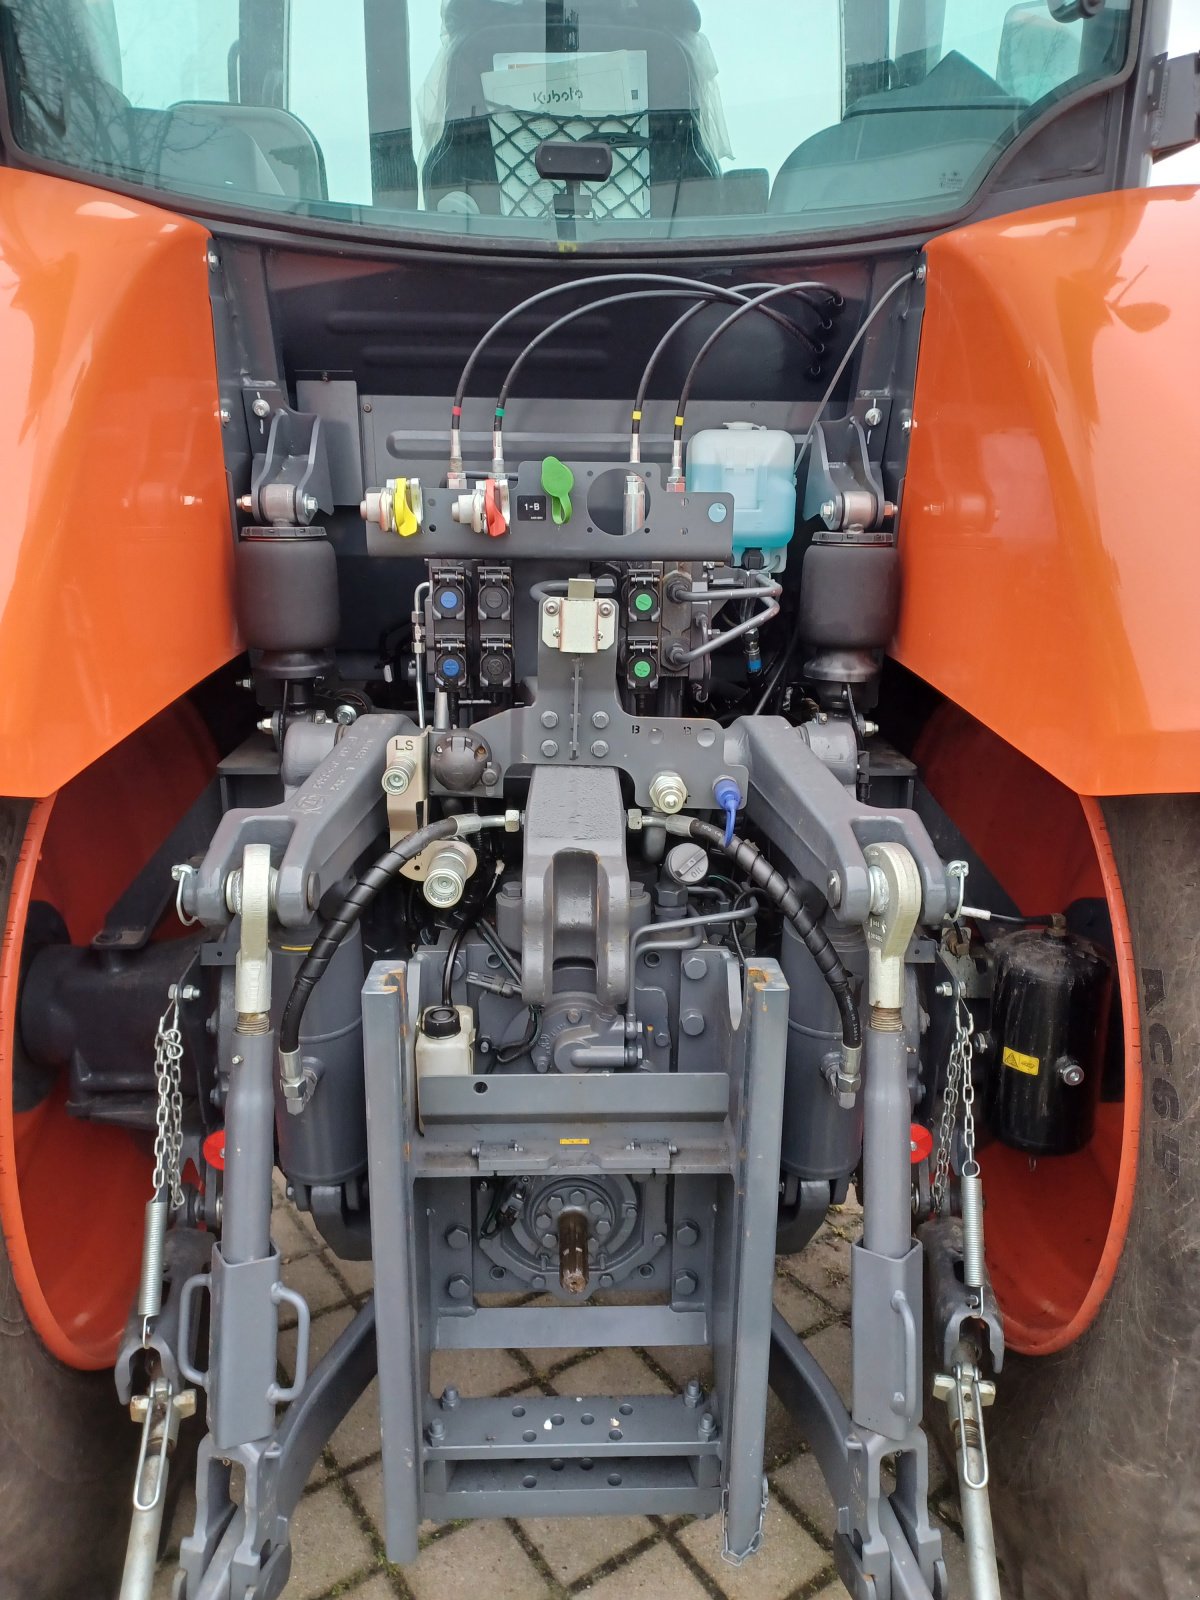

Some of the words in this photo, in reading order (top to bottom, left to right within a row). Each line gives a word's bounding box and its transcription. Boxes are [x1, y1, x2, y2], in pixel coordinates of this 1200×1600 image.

[533, 87, 584, 104] Kubota
[525, 502, 540, 510] 1-B
[395, 739, 414, 751] LS
[690, 867, 703, 878] OIL
